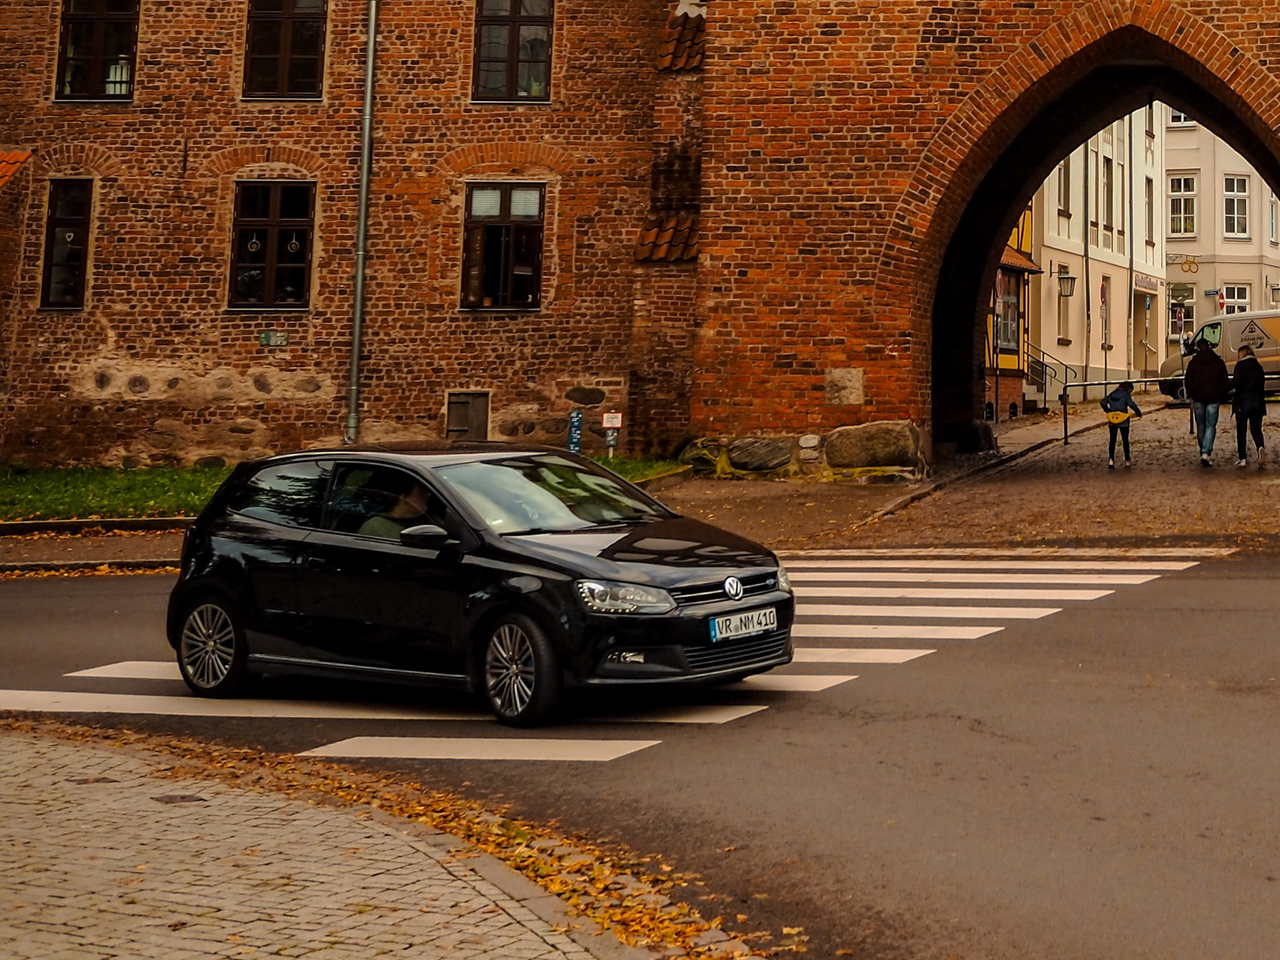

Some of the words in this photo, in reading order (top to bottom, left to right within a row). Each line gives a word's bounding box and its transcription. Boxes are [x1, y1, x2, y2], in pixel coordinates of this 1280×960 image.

[717, 618, 733, 635] VR
[740, 614, 755, 631] NM
[757, 610, 775, 627] 410
